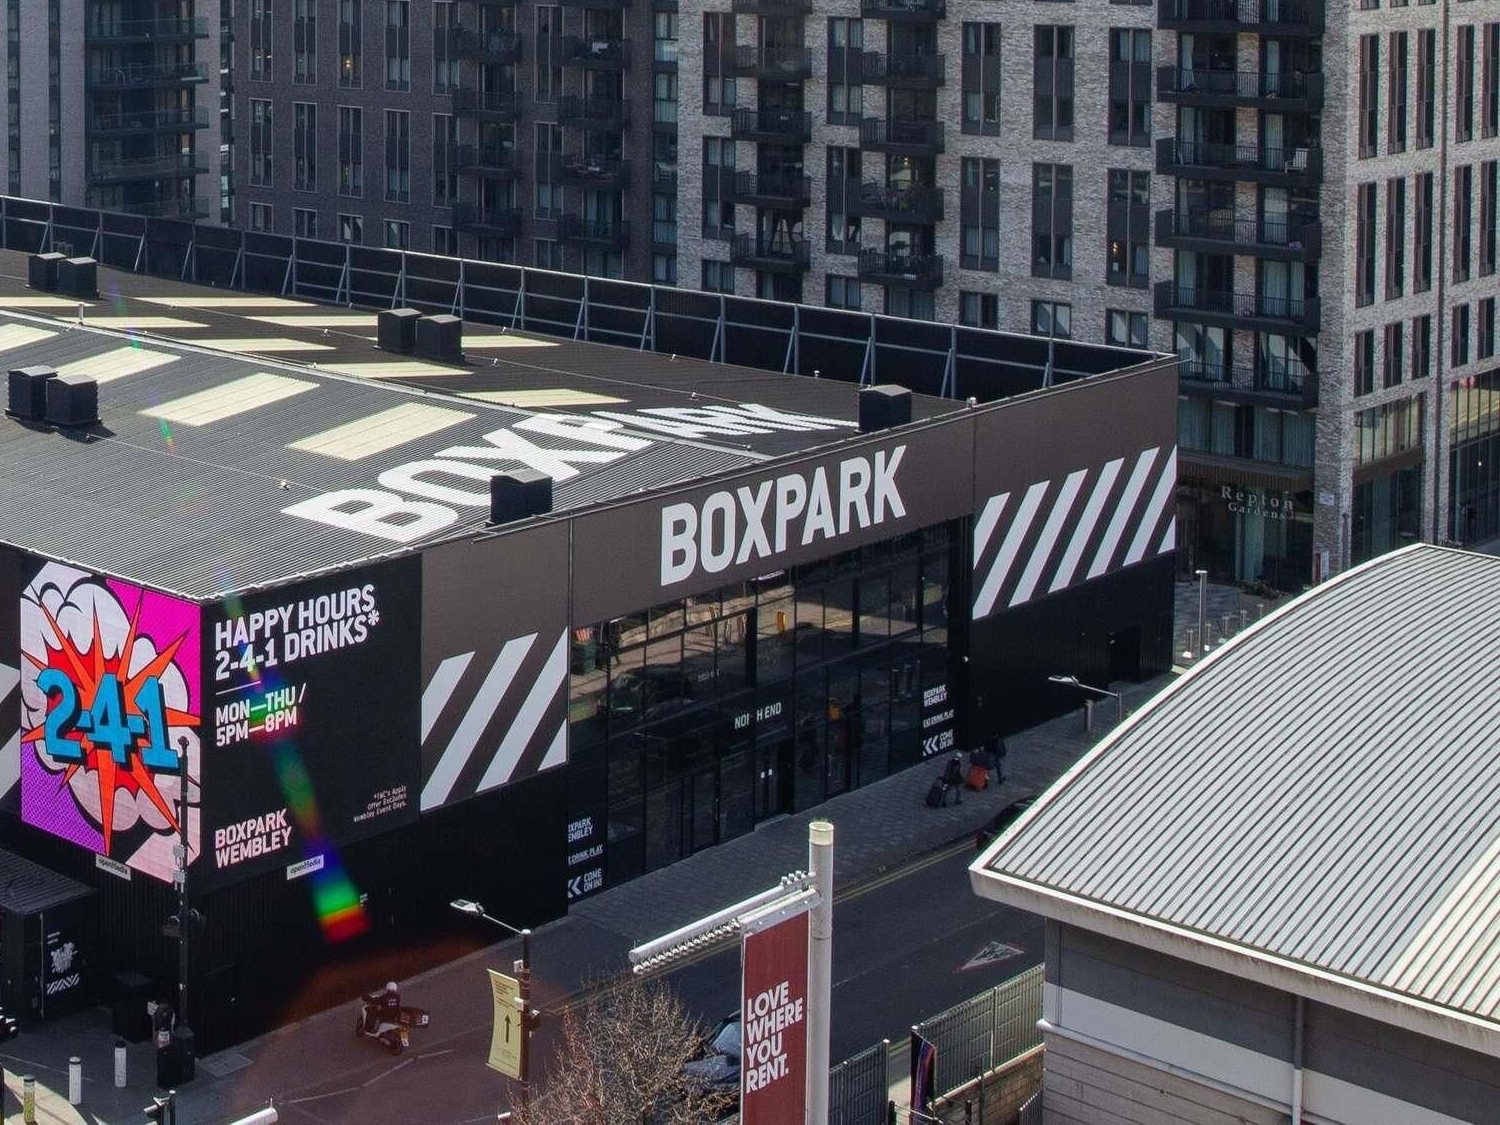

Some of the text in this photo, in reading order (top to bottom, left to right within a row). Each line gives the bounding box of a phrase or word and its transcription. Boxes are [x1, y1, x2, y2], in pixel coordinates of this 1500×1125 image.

[280, 403, 862, 544] BOXPARK
[660, 444, 907, 587] BOXPARK
[1220, 484, 1293, 510] Repton
[1228, 502, 1285, 519] Gardens
[215, 583, 376, 651] HAPPY HOURS
[215, 637, 278, 682] 2-4-1
[36, 667, 182, 775] 2-4-1
[734, 701, 782, 730] NOH END
[214, 808, 288, 849] BOXPARK
[568, 816, 591, 832] XPARK
[568, 825, 593, 843] EMBLEY
[215, 826, 293, 870] WEMBLEY
[589, 843, 603, 858] PLAY
[583, 868, 602, 883] COME
[583, 880, 593, 892] ON
[746, 996, 804, 1045] WHERE
[747, 980, 789, 1022] LOVE
[746, 1032, 782, 1069] YOU
[745, 1052, 790, 1094] RENT.
